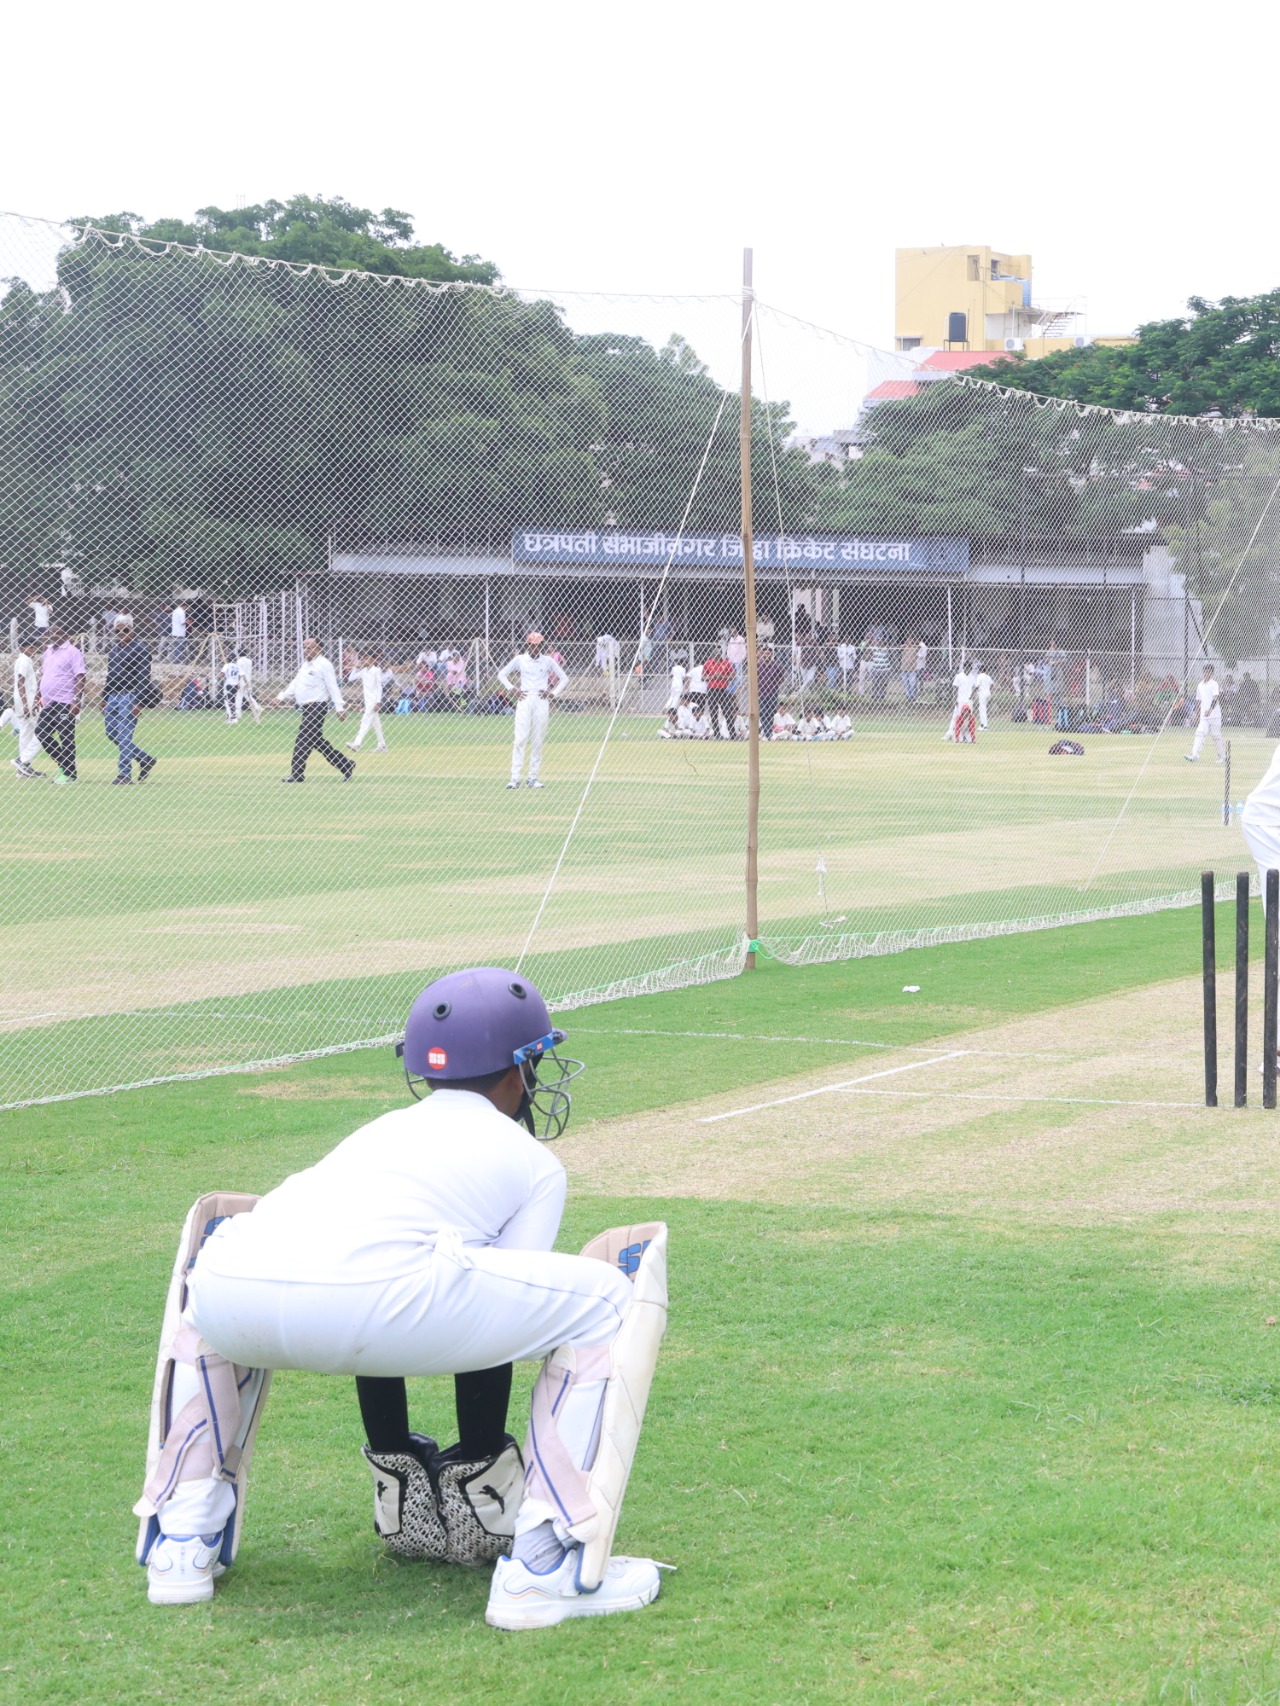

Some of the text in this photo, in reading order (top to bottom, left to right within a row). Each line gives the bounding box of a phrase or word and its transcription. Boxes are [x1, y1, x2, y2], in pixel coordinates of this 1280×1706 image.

[523, 531, 598, 553] छत्रपती
[603, 532, 716, 557] संभाजीनगर
[841, 537, 911, 561] संघटना
